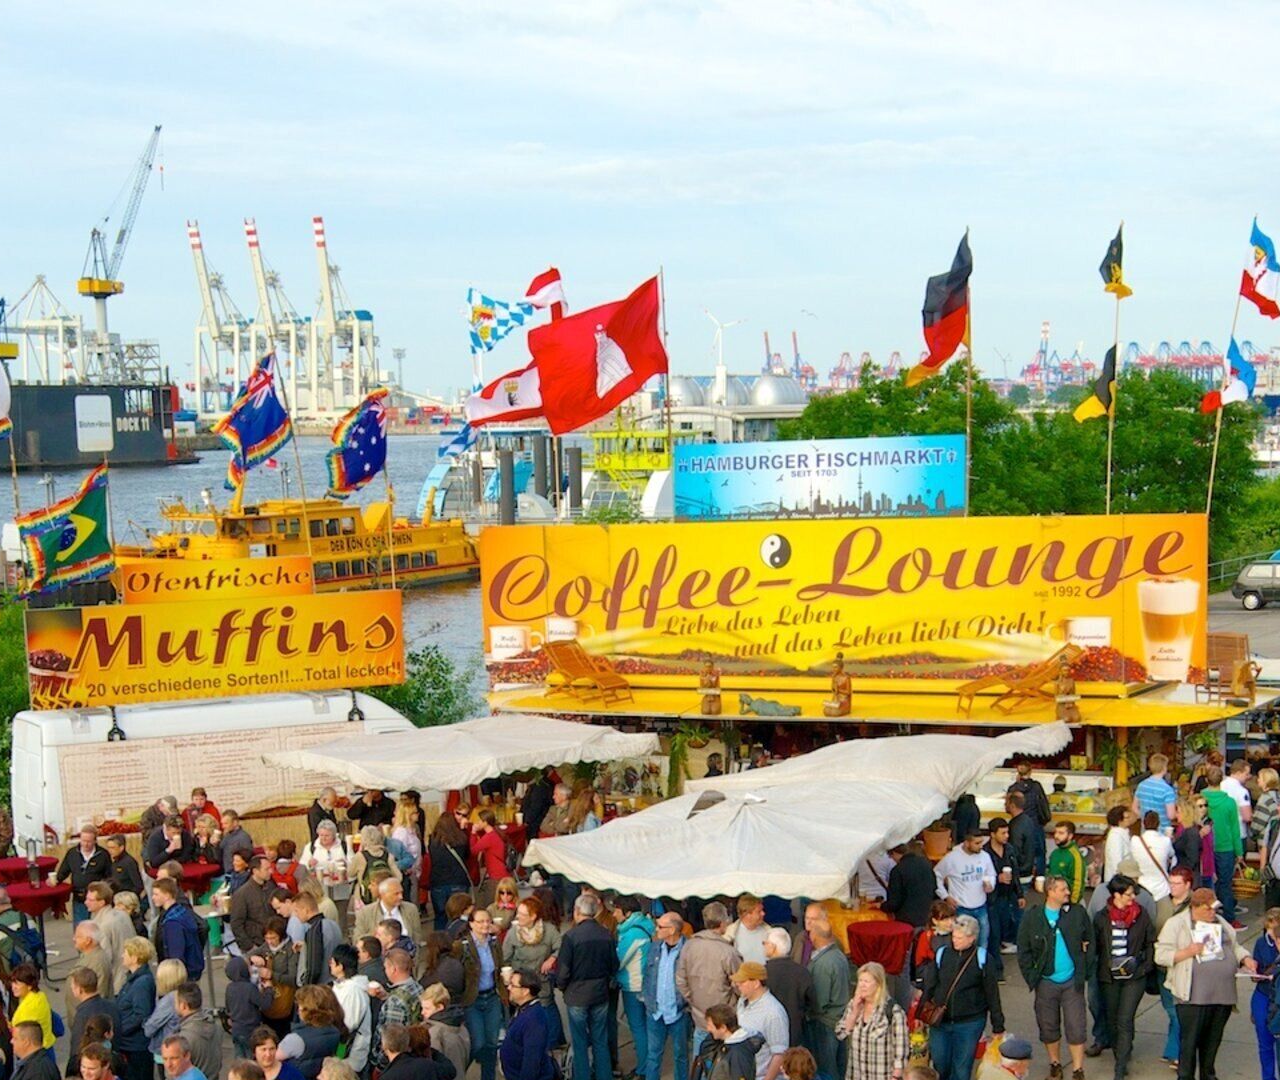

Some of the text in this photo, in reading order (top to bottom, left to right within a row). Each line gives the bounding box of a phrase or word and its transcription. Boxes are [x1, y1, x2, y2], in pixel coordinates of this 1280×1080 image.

[116, 416, 150, 432] DOCK 11
[691, 448, 944, 473] HAMBURGER FISCHMARKT
[816, 469, 838, 477] 1703
[127, 564, 310, 593] Ofenfrische
[1051, 586, 1081, 598] 1992
[661, 603, 841, 637] Liebe das Leben
[733, 611, 1047, 658] und das Leben liebt Dich!
[71, 605, 397, 670] Muffins
[87, 683, 106, 697] 20
[111, 675, 221, 696] verschiedene
[345, 662, 401, 681] lecker!!
